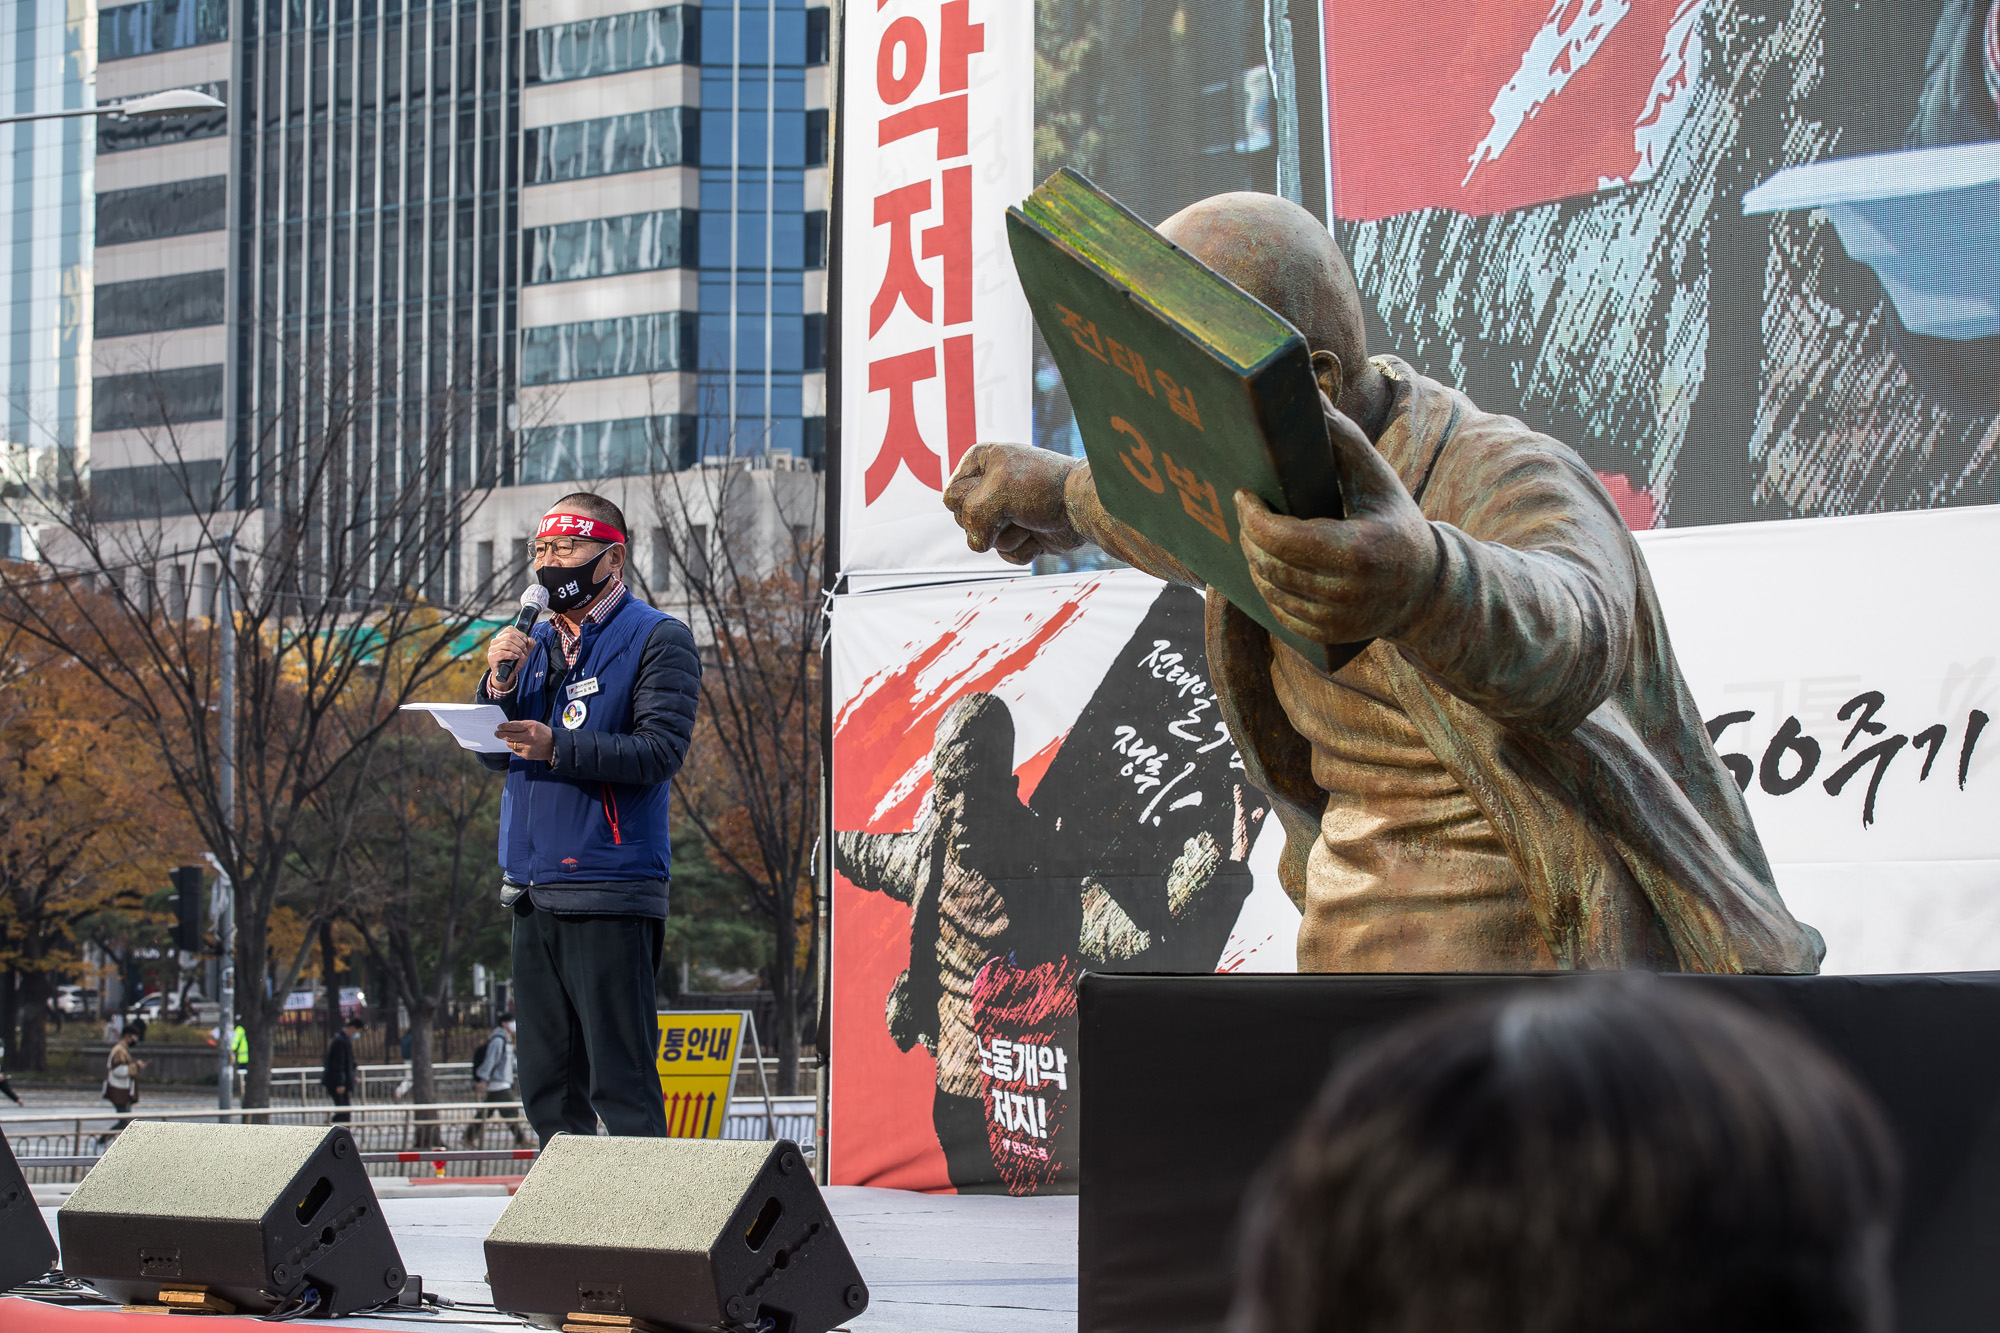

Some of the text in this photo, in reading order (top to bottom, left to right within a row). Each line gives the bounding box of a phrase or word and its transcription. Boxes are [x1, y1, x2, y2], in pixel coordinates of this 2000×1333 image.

[864, 0, 985, 508] 악저지
[1056, 302, 1205, 432] 전태일
[1110, 425, 1232, 545] 3법
[557, 515, 595, 537] 투쟁
[557, 579, 580, 599] 3법
[656, 1027, 732, 1062] 통안내
[976, 1034, 1068, 1091] 노동개악
[991, 1087, 1048, 1139] 저지!
